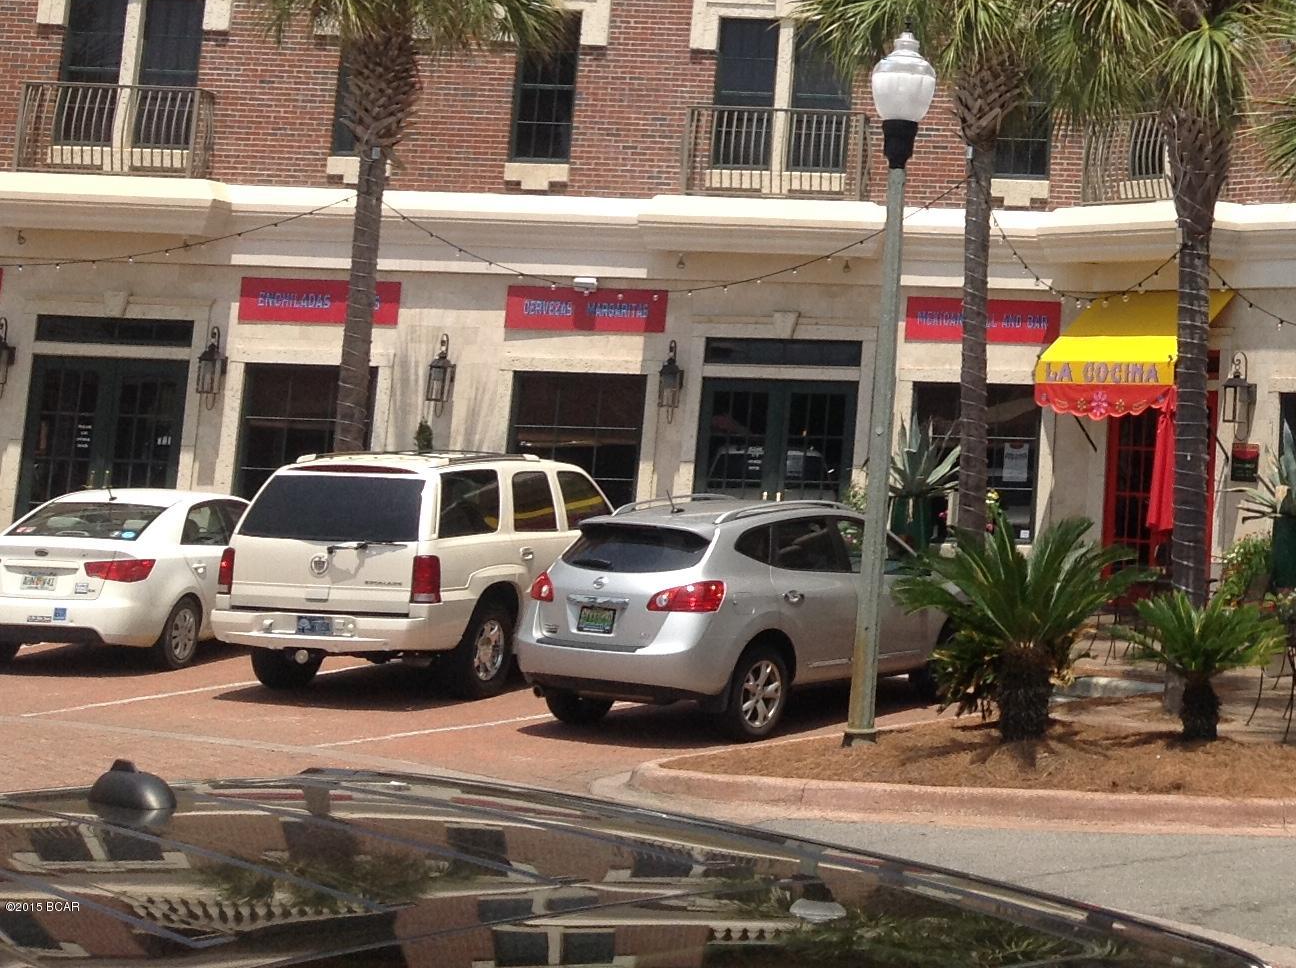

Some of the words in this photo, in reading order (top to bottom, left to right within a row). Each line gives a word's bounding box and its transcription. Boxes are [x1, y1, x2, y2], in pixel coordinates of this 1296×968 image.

[257, 291, 331, 309] ENCHILADAS
[523, 299, 574, 317] CERVEZAS
[587, 301, 649, 319] MARGARITAS
[1001, 315, 1022, 329] AND
[1026, 315, 1049, 330] BAR
[1046, 362, 1073, 383] LA
[1083, 362, 1159, 384] COCINA
